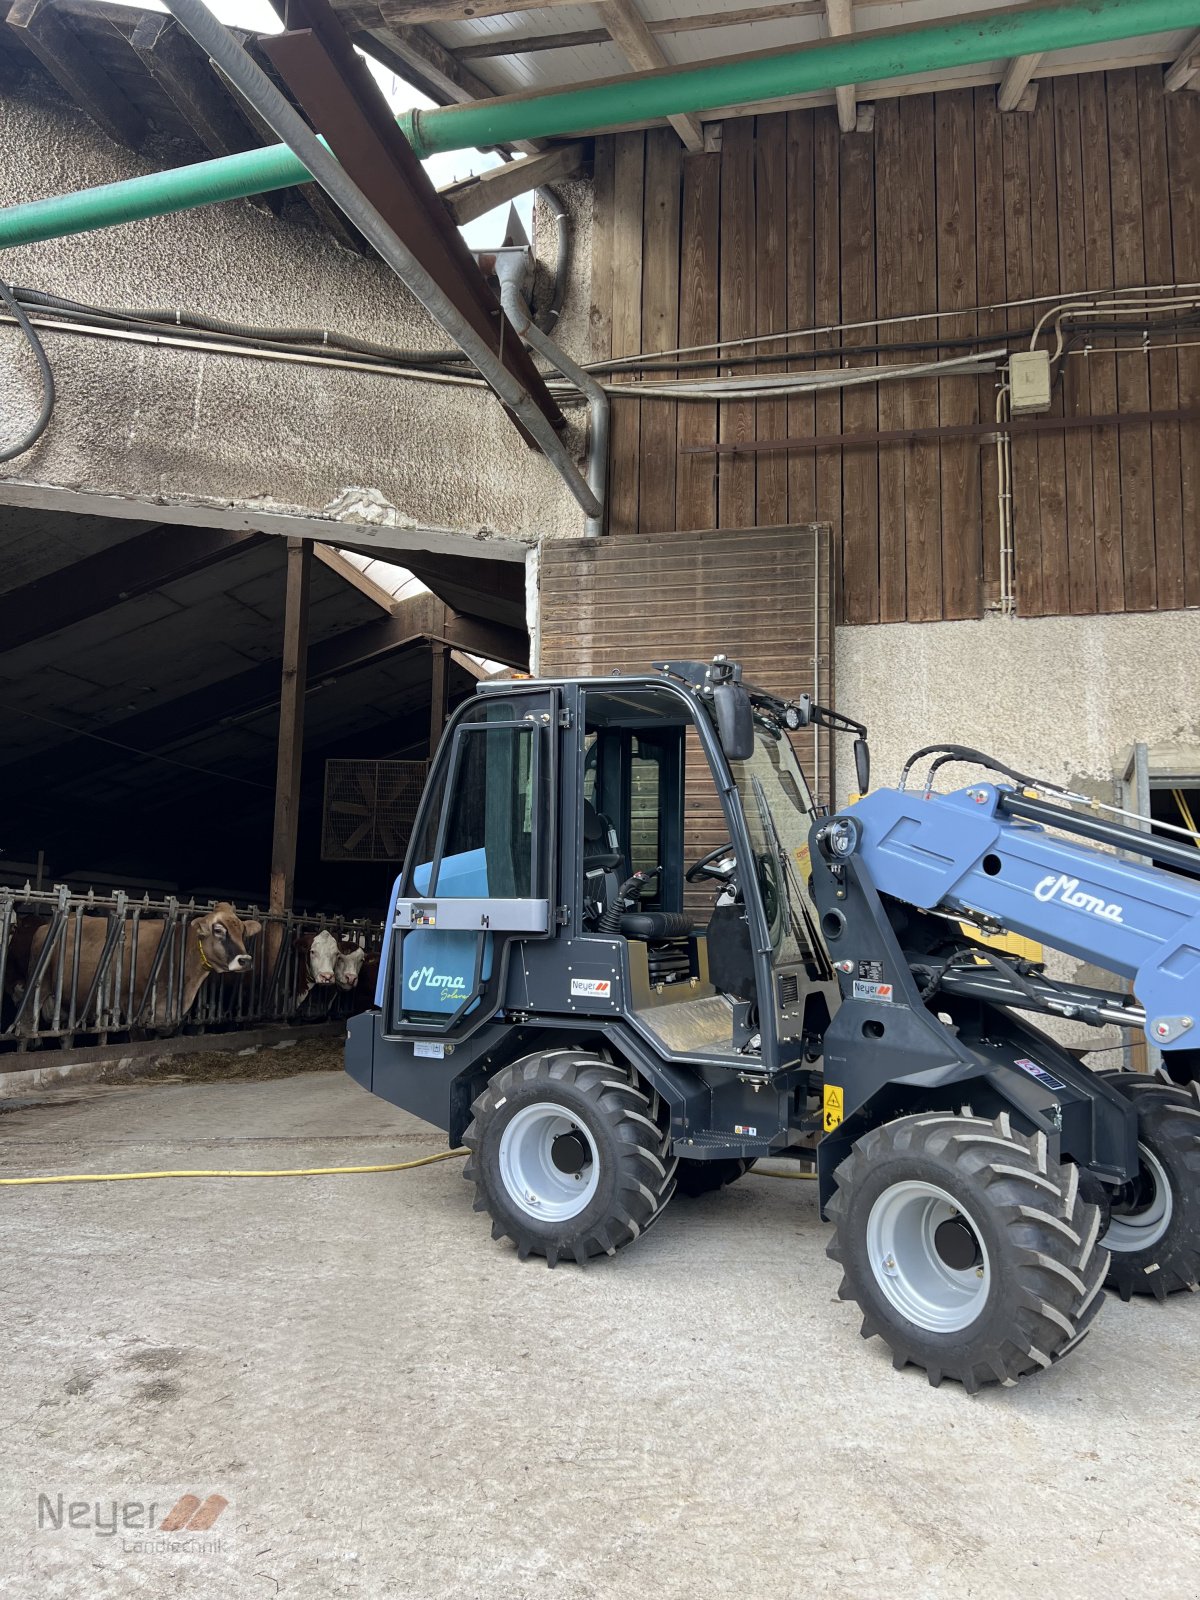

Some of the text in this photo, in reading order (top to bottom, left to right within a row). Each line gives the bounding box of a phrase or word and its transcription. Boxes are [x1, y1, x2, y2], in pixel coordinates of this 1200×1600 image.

[1034, 874, 1123, 923] Mona
[408, 966, 466, 991] Mona
[572, 980, 596, 991] Neyer
[854, 982, 877, 994] Neyer
